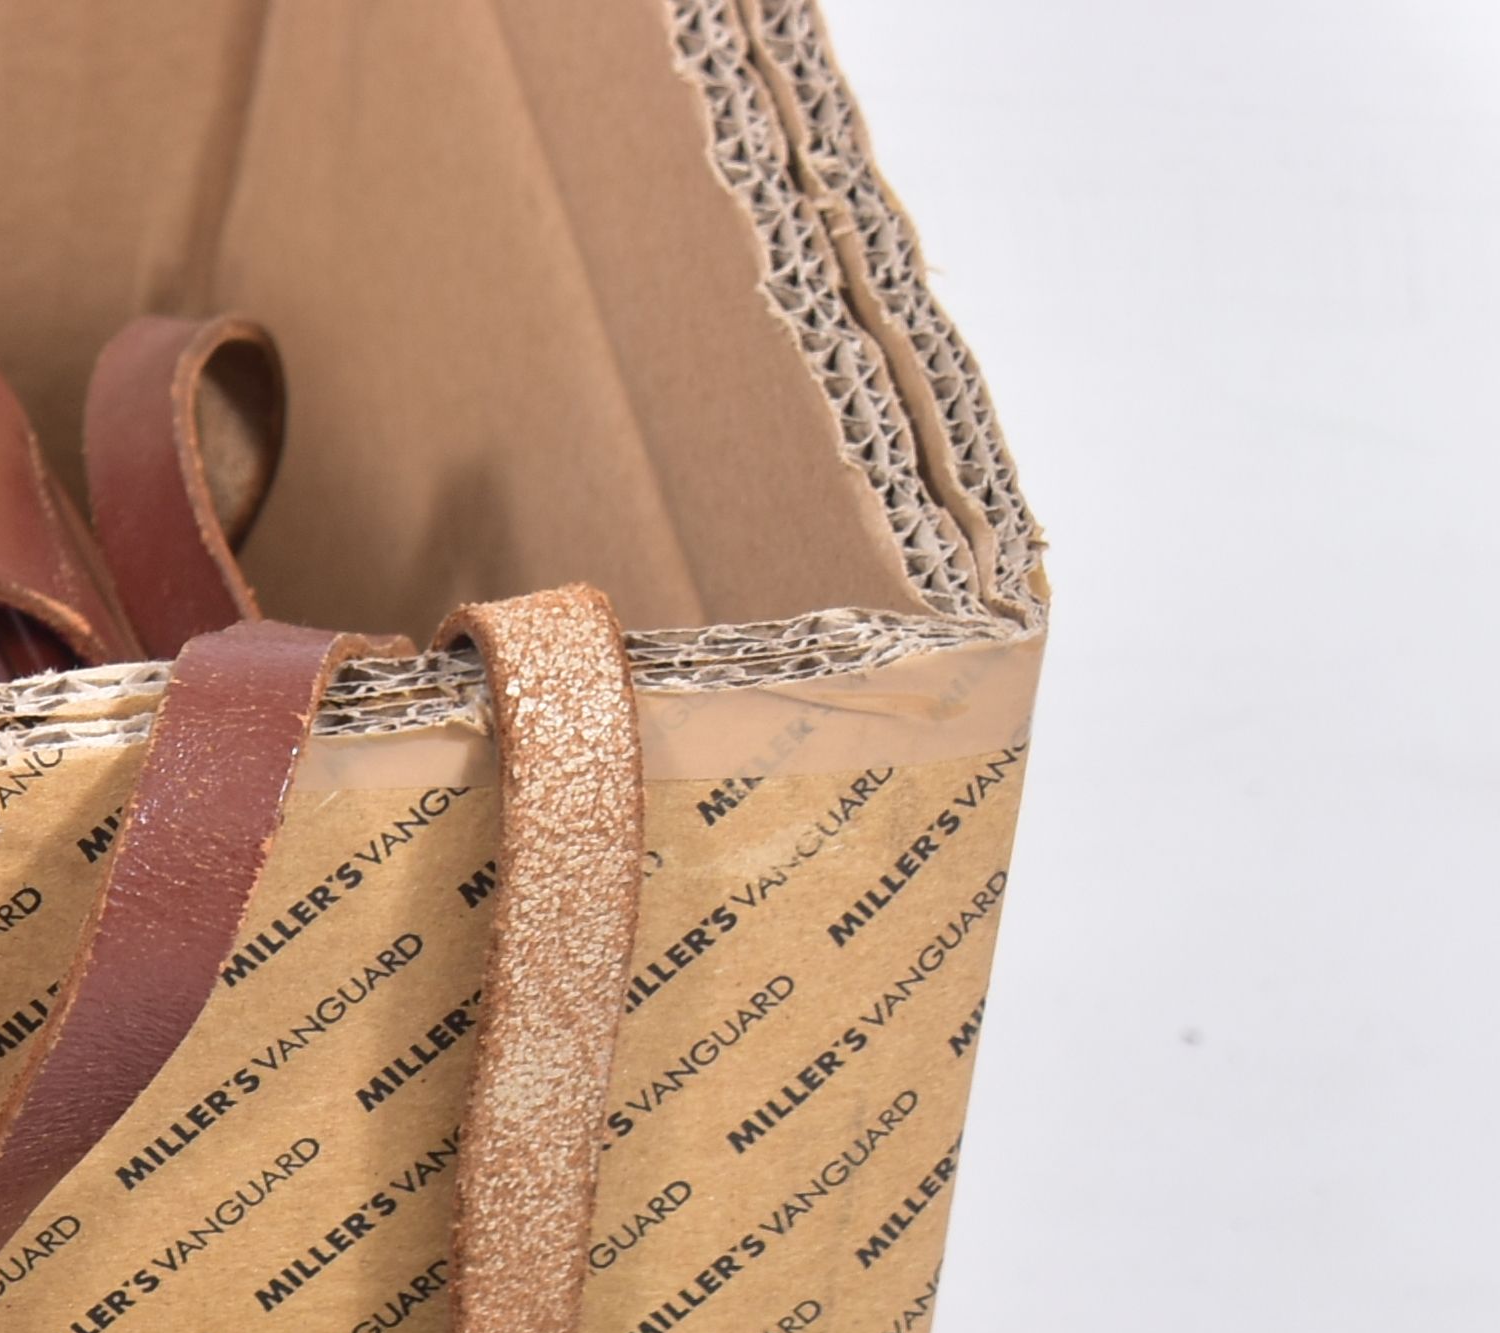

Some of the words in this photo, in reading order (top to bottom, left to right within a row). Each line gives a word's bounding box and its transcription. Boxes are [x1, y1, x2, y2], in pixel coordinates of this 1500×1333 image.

[115, 1068, 260, 1191] MILLER'S
[250, 933, 423, 1070] VANGUARD
[727, 1027, 867, 1154] MILLER'S
[860, 871, 1007, 1026] VANGUARD
[151, 1138, 320, 1271] VANGUARD
[759, 1090, 918, 1235] VANGUARD
